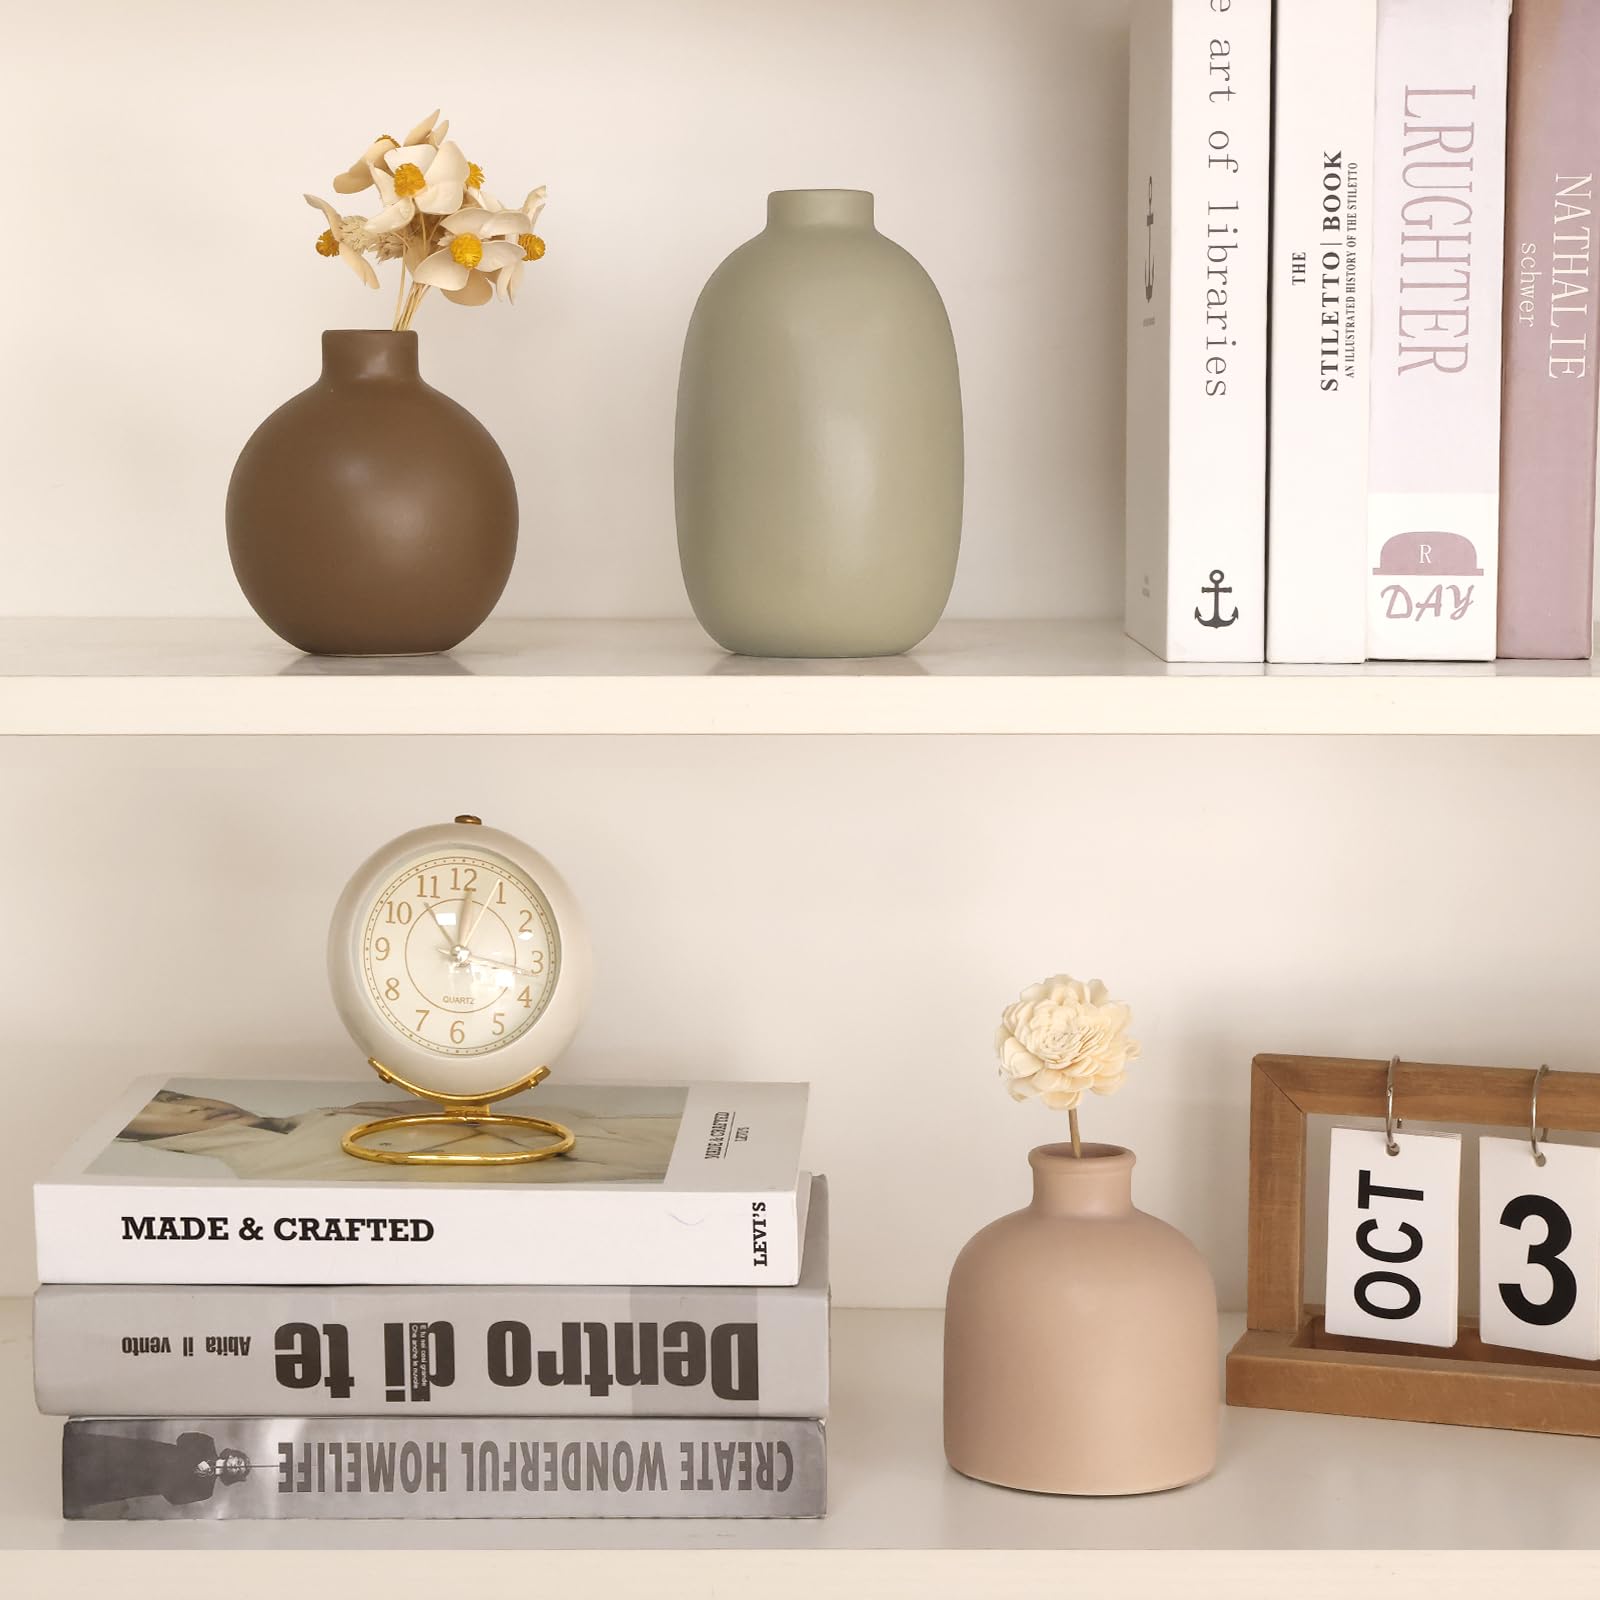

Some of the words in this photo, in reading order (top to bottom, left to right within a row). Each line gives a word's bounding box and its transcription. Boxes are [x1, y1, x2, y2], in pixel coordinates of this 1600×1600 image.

[1208, 39, 1237, 103] art
[1208, 130, 1239, 174] of
[1322, 150, 1342, 232] BOOK
[1347, 162, 1358, 210] STILETTO
[1346, 213, 1357, 232] THE
[1398, 85, 1477, 376] LRUGHTER
[1346, 235, 1357, 248] OF
[1291, 252, 1306, 285] THE
[1345, 251, 1356, 293] HISTORY
[1519, 243, 1543, 327] schwer
[1549, 173, 1593, 379] NATHALIE
[1205, 201, 1240, 397] libraries
[1320, 251, 1340, 392] STILETTO
[1344, 296, 1356, 362] ILLUSTRATED
[1344, 365, 1355, 378] AN
[1419, 544, 1432, 564] R
[1380, 584, 1475, 622] DAY
[416, 875, 441, 899] 11
[450, 868, 478, 892] 12
[496, 881, 507, 905] 1
[385, 901, 413, 925] 10
[519, 909, 533, 934] 2
[374, 937, 391, 961] 9
[531, 951, 544, 975] 3
[384, 977, 401, 1001] 8
[442, 995, 476, 1005] QUARTZ
[517, 985, 533, 1009] 4
[415, 1009, 430, 1032] 7
[450, 1020, 465, 1044] 6
[491, 1012, 506, 1036] 5
[121, 1216, 229, 1241] MADE
[238, 1217, 264, 1241] &
[273, 1217, 435, 1242] CRAFTED
[752, 1201, 768, 1267] LEVI'S
[1354, 1169, 1424, 1320] OCT
[1498, 1194, 1578, 1326] 3
[121, 1336, 172, 1357] vento
[183, 1336, 194, 1357] il
[205, 1336, 252, 1357] Abita
[274, 1322, 355, 1399] te
[384, 1321, 456, 1402] di
[487, 1321, 760, 1401] Dentro
[278, 1440, 447, 1494] HOMELIFE
[462, 1440, 668, 1493] WONDERFUL
[680, 1440, 794, 1493] CREATE
